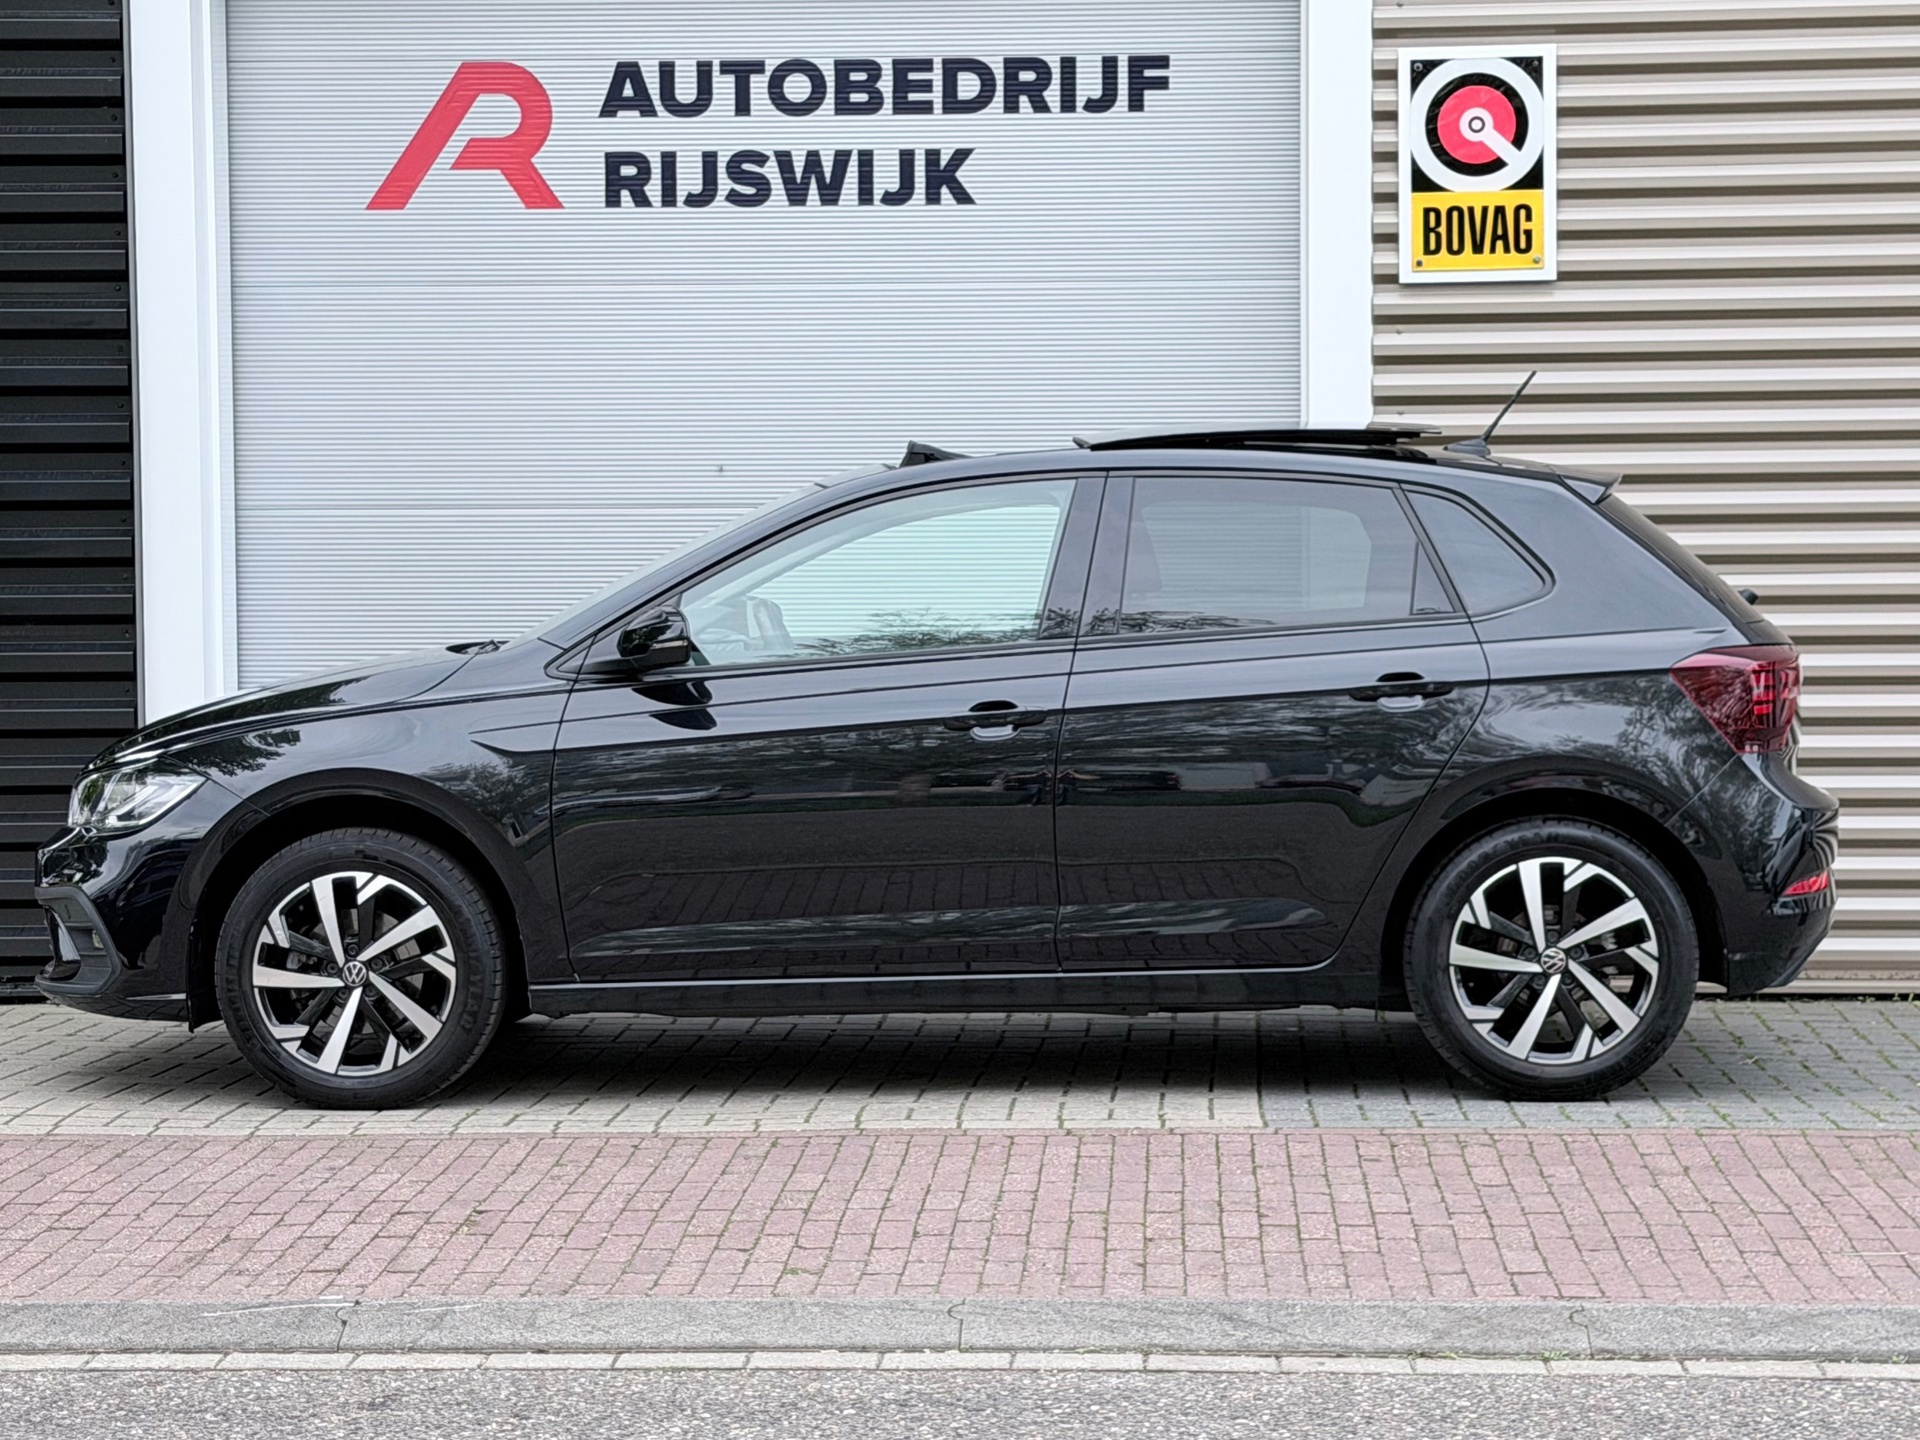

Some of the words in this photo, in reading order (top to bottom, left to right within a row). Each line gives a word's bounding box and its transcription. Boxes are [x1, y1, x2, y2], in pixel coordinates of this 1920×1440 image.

[598, 55, 1171, 118] AUTOBEDRIJF
[604, 148, 976, 208] RIJSWIJK
[1422, 203, 1534, 256] BOVAG
